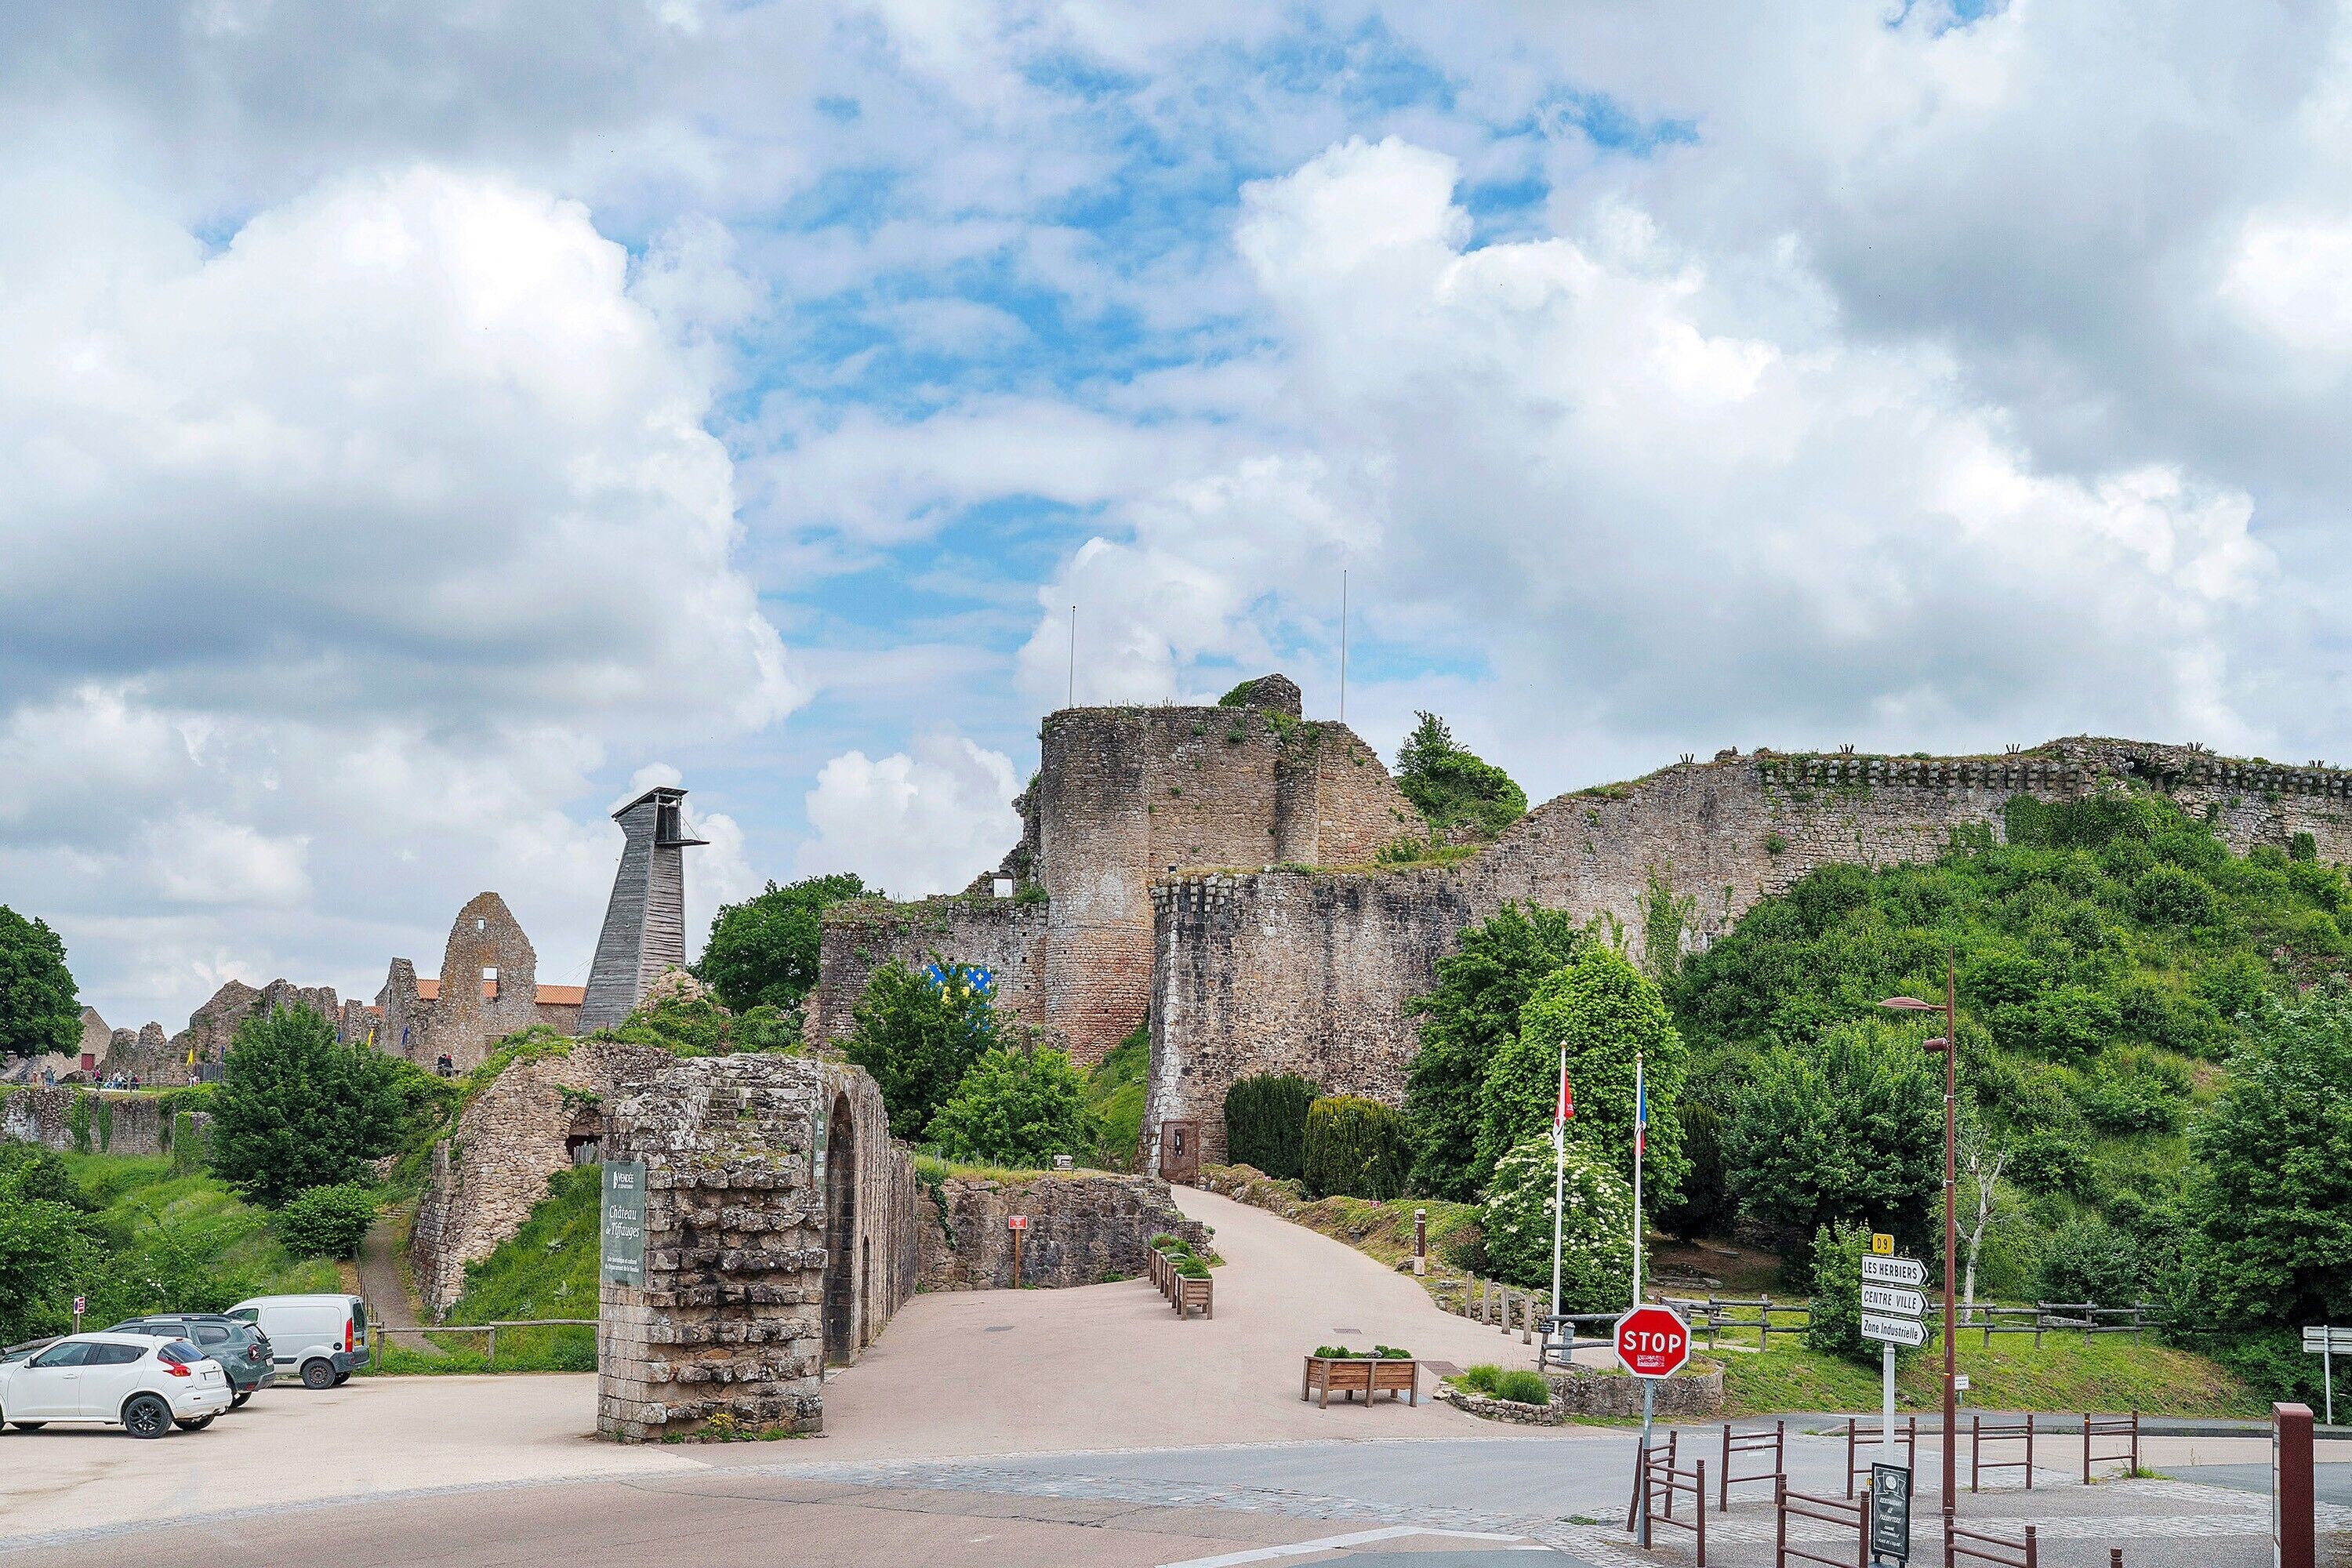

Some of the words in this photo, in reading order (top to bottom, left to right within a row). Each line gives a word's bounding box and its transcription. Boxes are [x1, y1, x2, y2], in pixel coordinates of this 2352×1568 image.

[618, 1172, 634, 1183] VENDÉE
[609, 1205, 637, 1221] Château
[605, 1225, 612, 1235] de
[612, 1221, 640, 1240] Tiffauges
[1864, 1261, 1877, 1274] LES
[1879, 1263, 1918, 1279] HERBIERS
[1864, 1290, 1892, 1305] CENTRE
[1896, 1295, 1917, 1309] VILLE
[1864, 1319, 1879, 1334] Zone
[1881, 1323, 1918, 1340] Industrielle
[1623, 1330, 1682, 1353] STOP
